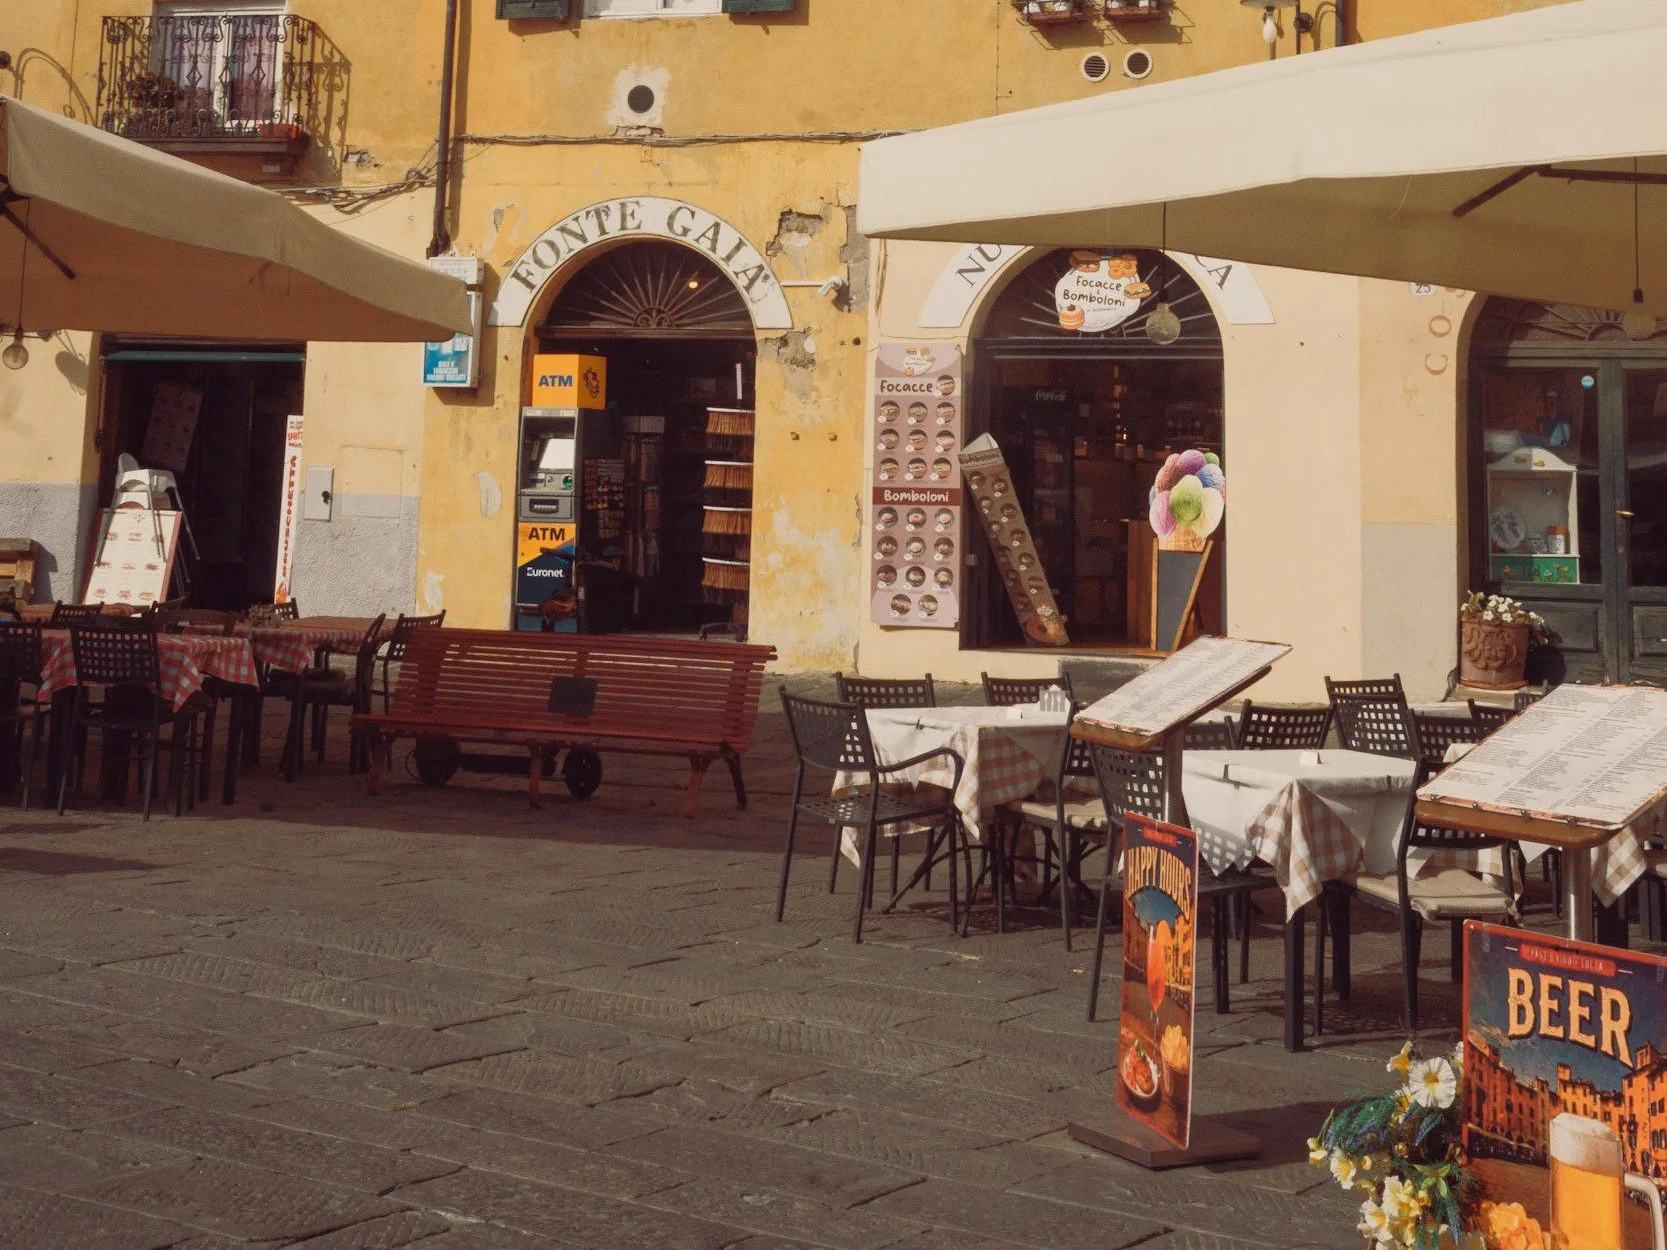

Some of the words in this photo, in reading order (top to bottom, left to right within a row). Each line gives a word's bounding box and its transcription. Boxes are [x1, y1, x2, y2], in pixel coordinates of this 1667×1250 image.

[510, 200, 643, 294] FONTE
[666, 206, 770, 295] GAIA
[955, 243, 1002, 288] NU
[1076, 275, 1122, 291] Focacce
[1063, 289, 1126, 307] Bomboloni
[538, 375, 573, 387] ATM
[880, 379, 933, 393] Focacce
[883, 490, 949, 503] Bomboloni
[528, 527, 565, 541] ATM
[526, 567, 564, 578] Euronet
[1128, 845, 1158, 897] HAPPY
[1159, 848, 1191, 921] HOURS
[1580, 959, 1603, 971] LUCCA
[1508, 967, 1634, 1068] BEER
